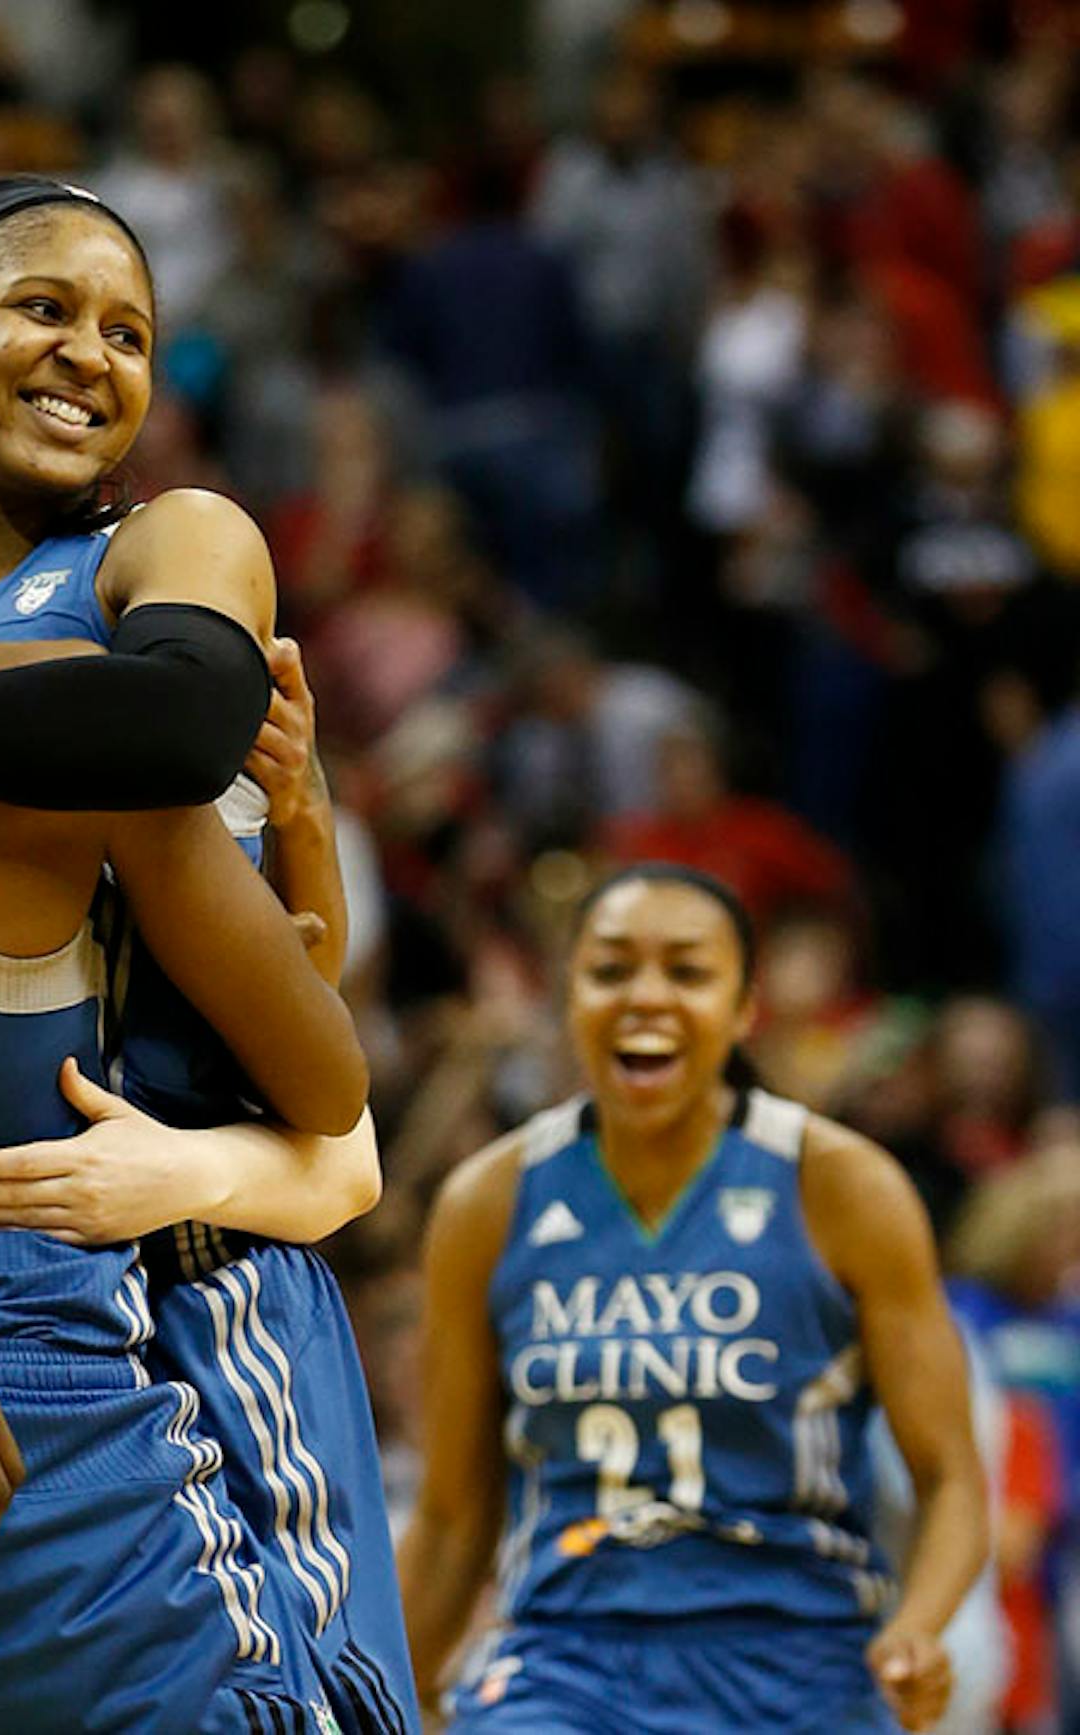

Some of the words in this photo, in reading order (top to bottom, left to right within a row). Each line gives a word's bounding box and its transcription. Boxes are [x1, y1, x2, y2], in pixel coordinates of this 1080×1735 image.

[532, 1271, 761, 1341] MAYO
[512, 1338, 779, 1404] CLINIC
[576, 1404, 705, 1524] 21
